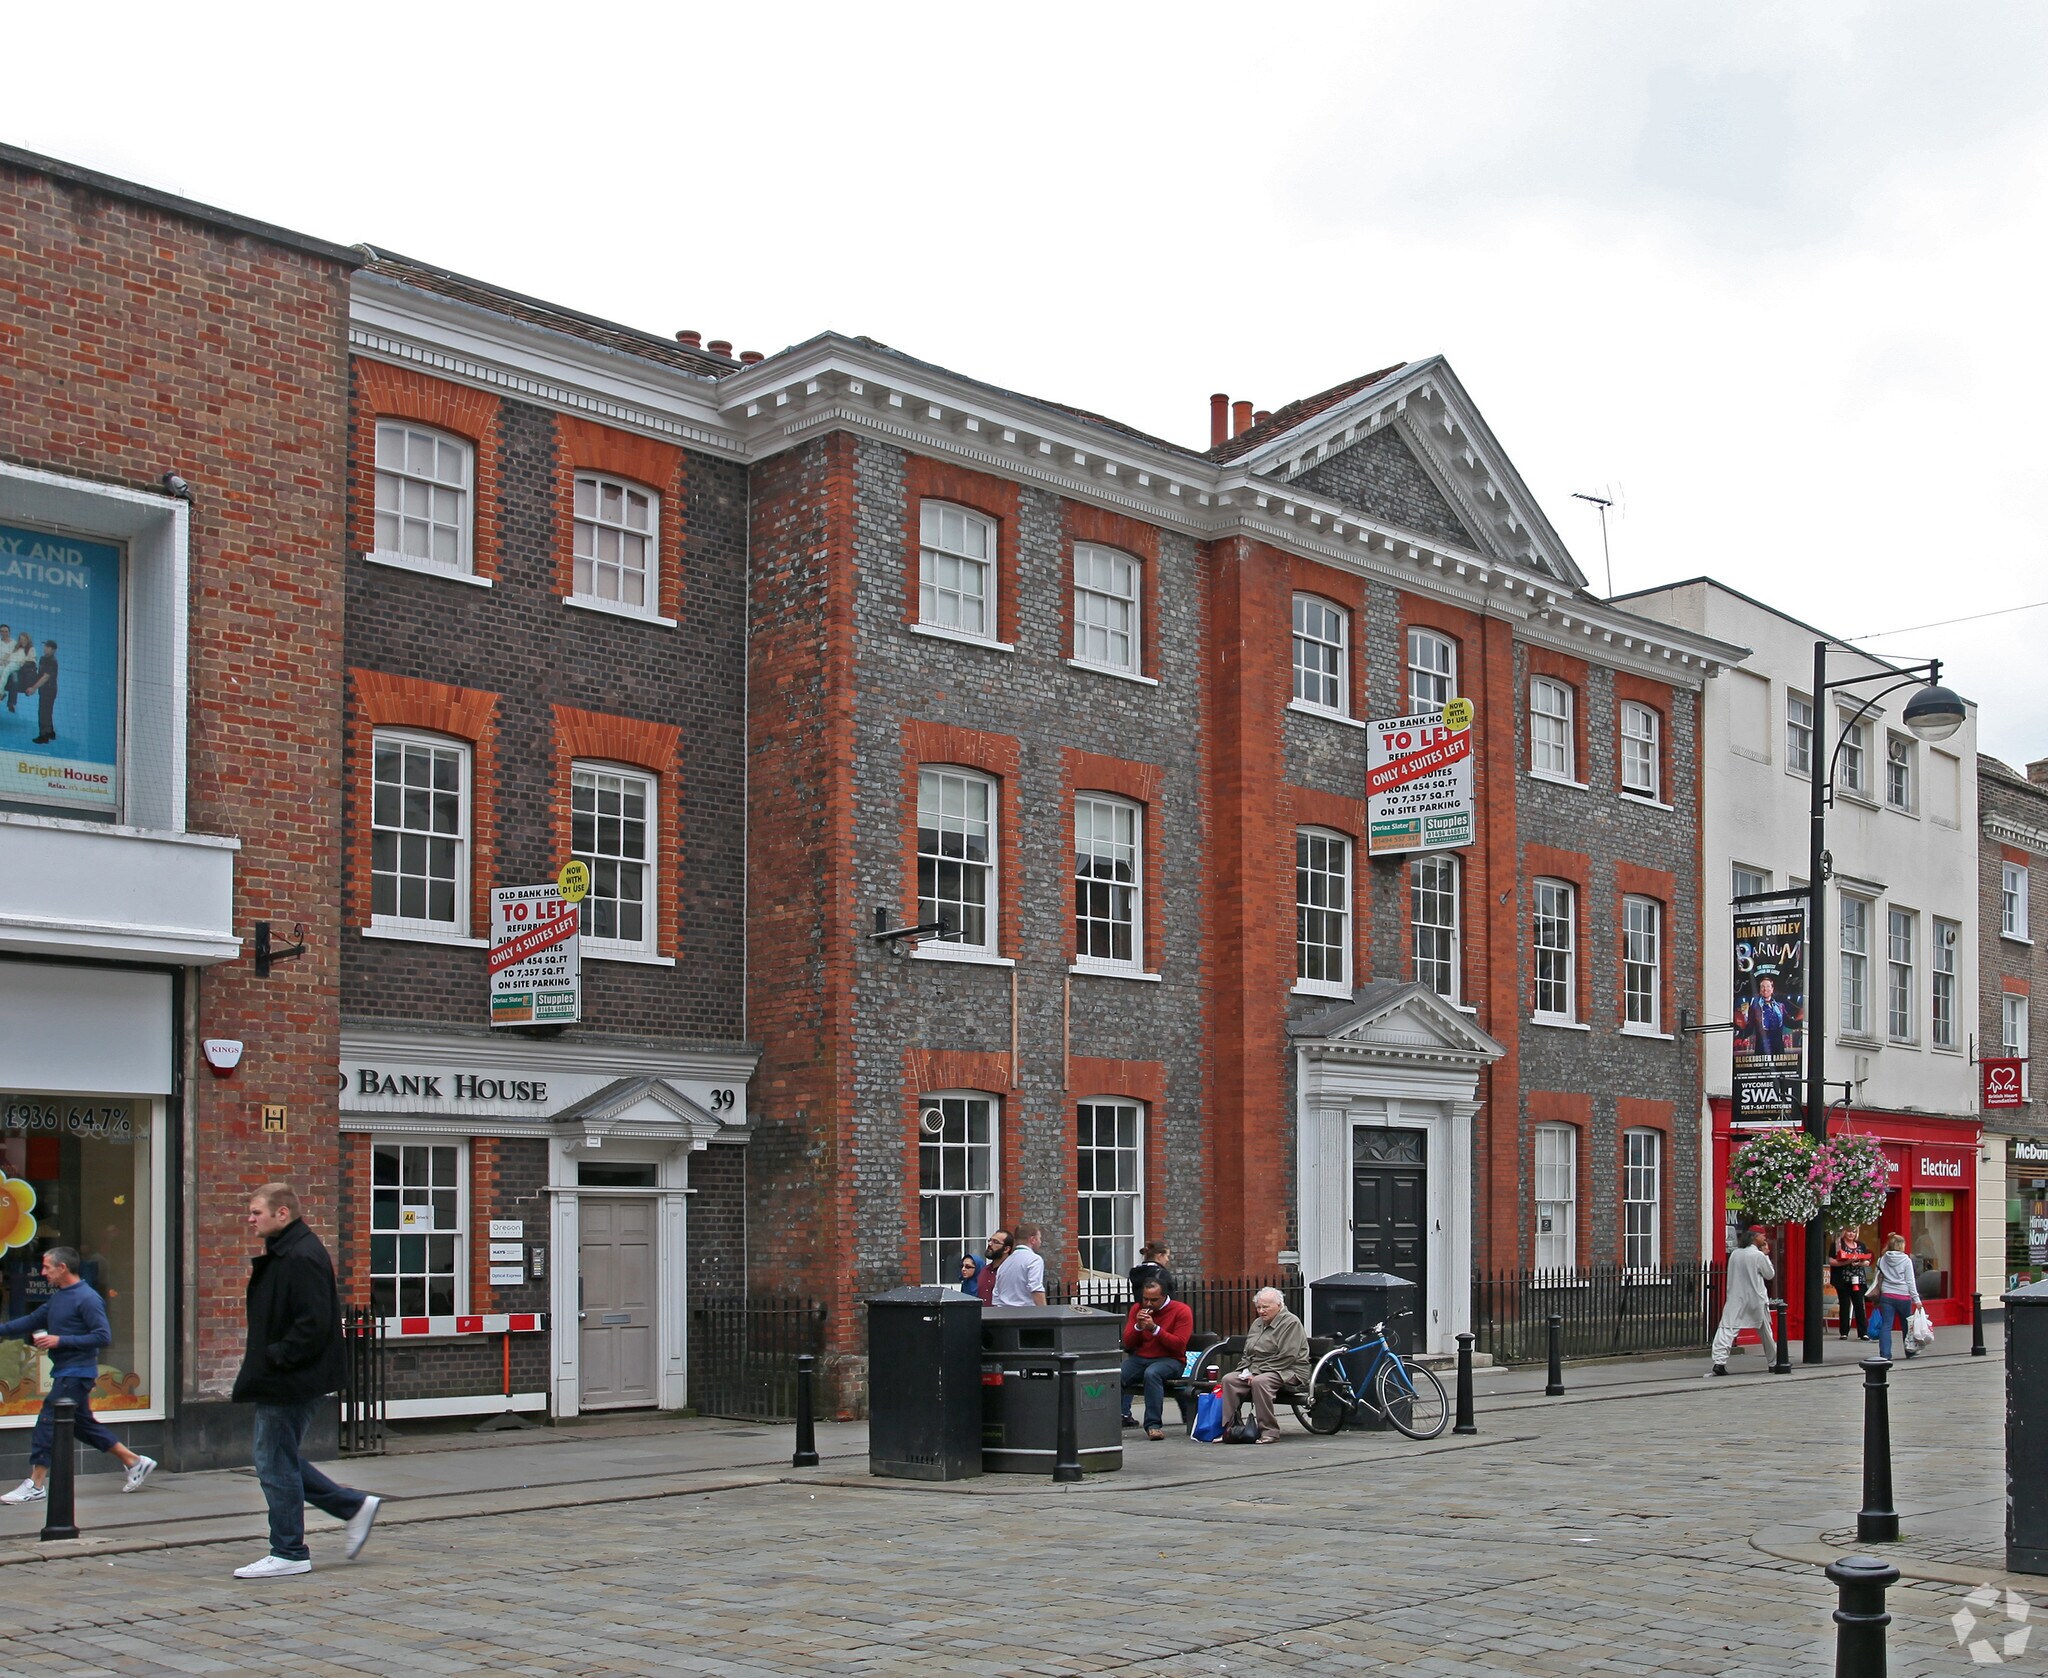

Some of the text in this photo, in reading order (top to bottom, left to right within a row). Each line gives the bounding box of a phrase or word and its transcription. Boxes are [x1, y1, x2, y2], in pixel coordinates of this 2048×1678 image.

[30, 542, 83, 566] AND
[1449, 702, 1464, 710] NOW
[1449, 709, 1465, 717] WITH
[1378, 722, 1396, 730] OLD
[1400, 717, 1426, 728] BANK
[1383, 726, 1453, 751] TO LET
[1372, 767, 1399, 786] ONLY
[1401, 764, 1408, 774] 4
[1409, 749, 1443, 772] SUITES
[1443, 739, 1465, 758] LEFT
[18, 762, 108, 784] BrightHouse
[1412, 782, 1430, 791] 454
[1432, 778, 1457, 788] SQ.FT
[1402, 793, 1427, 804] 7,357
[1429, 789, 1455, 800] SQ.FT
[1380, 800, 1461, 816] ON SITE PARKING
[1427, 816, 1467, 829] Stupples
[566, 866, 581, 875] NOW
[566, 876, 582, 884] WITH
[518, 890, 541, 898] BANK
[573, 884, 585, 892] USE
[502, 900, 567, 922] TO LET
[1736, 925, 1763, 938] BRIAN
[1765, 922, 1800, 936] CONLEY
[491, 947, 514, 965] ONLY
[516, 943, 522, 953] 4
[523, 928, 553, 950] SUITES
[555, 916, 574, 934] LEFT
[527, 957, 542, 966] 454
[545, 955, 568, 964] SQ.FT
[1736, 941, 1801, 972] BARNUM
[517, 969, 539, 978] 7,357
[542, 967, 565, 975] SQ.FT
[513, 980, 530, 988] SITE
[532, 978, 570, 988] PARKING
[538, 993, 574, 1005] Stupples
[710, 1089, 735, 1111] 39
[6, 1104, 130, 1131] £936 64.7%
[265, 1108, 284, 1130] H
[1921, 1158, 1961, 1177] Electrical
[404, 1213, 414, 1221] AA
[2030, 1215, 2048, 1231] Hiring
[2029, 1229, 2048, 1246] Now
[29, 1280, 46, 1288] THIS
